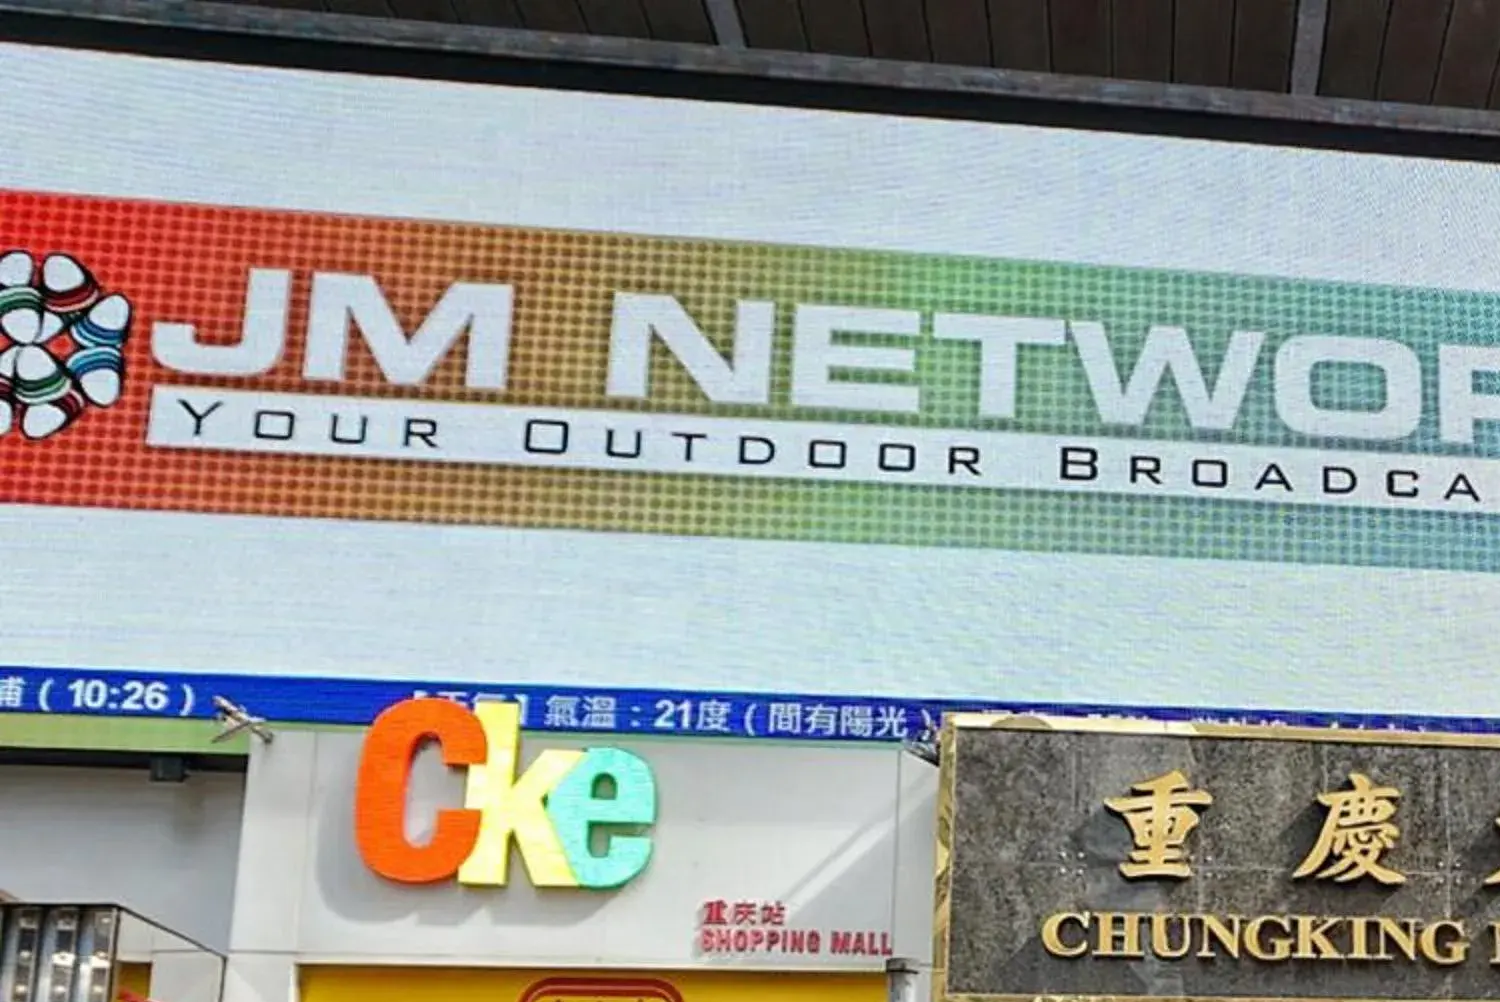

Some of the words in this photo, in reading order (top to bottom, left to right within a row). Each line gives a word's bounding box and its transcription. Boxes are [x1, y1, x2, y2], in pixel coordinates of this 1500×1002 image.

[151, 267, 515, 390] JM
[177, 399, 439, 449] YOUR
[525, 419, 981, 476] OUTDOOR
[701, 929, 822, 954] SHOPPING
[830, 930, 893, 956] MALL
[1041, 910, 1468, 966] CHUNGKING
